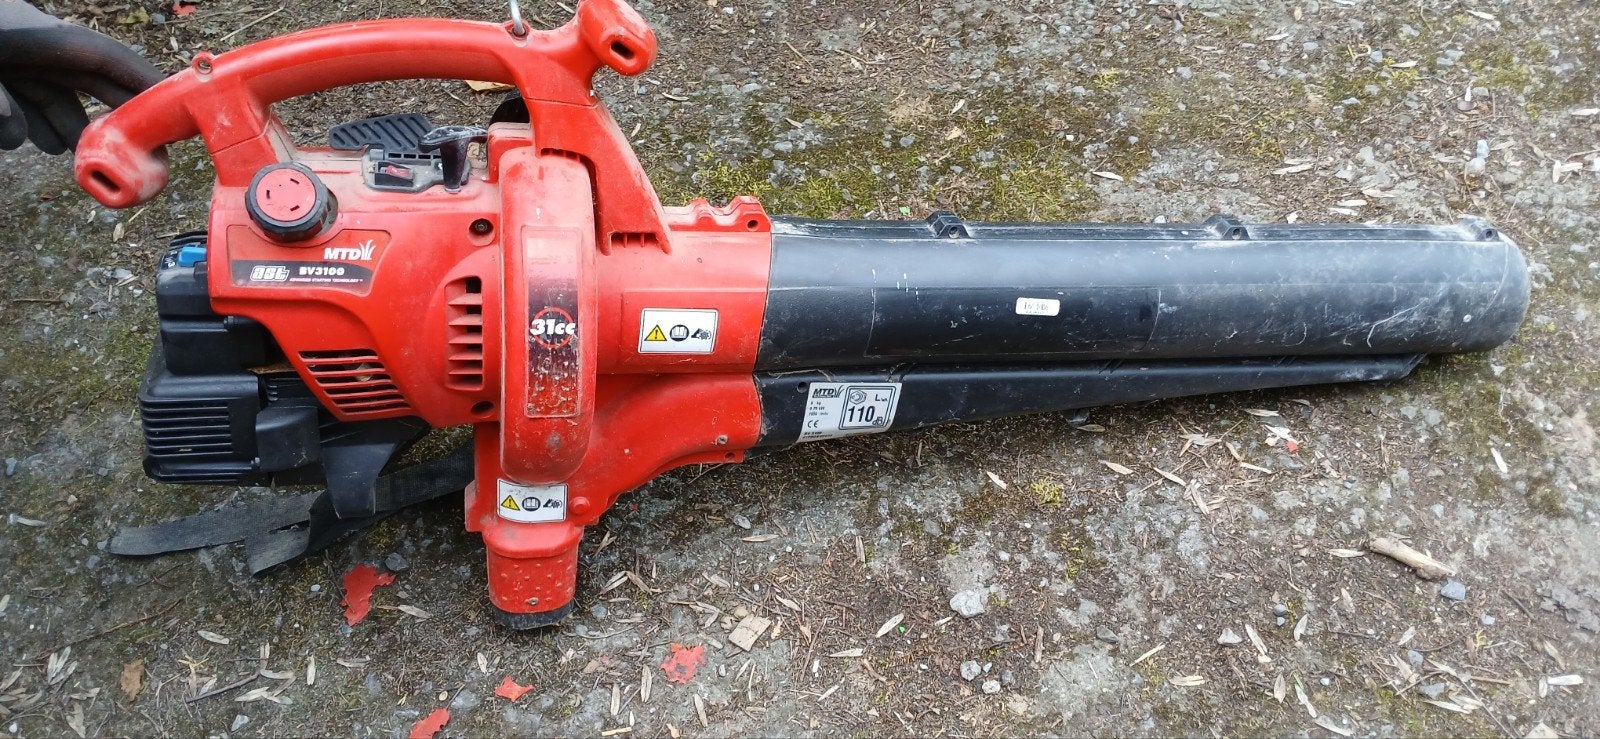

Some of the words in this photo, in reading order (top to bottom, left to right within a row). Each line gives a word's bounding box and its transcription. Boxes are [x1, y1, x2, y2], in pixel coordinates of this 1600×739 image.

[324, 247, 361, 261] MTD
[299, 266, 345, 276] BV3100
[530, 318, 576, 335] 31cc
[813, 388, 835, 397] MTD
[848, 405, 875, 422] 110
